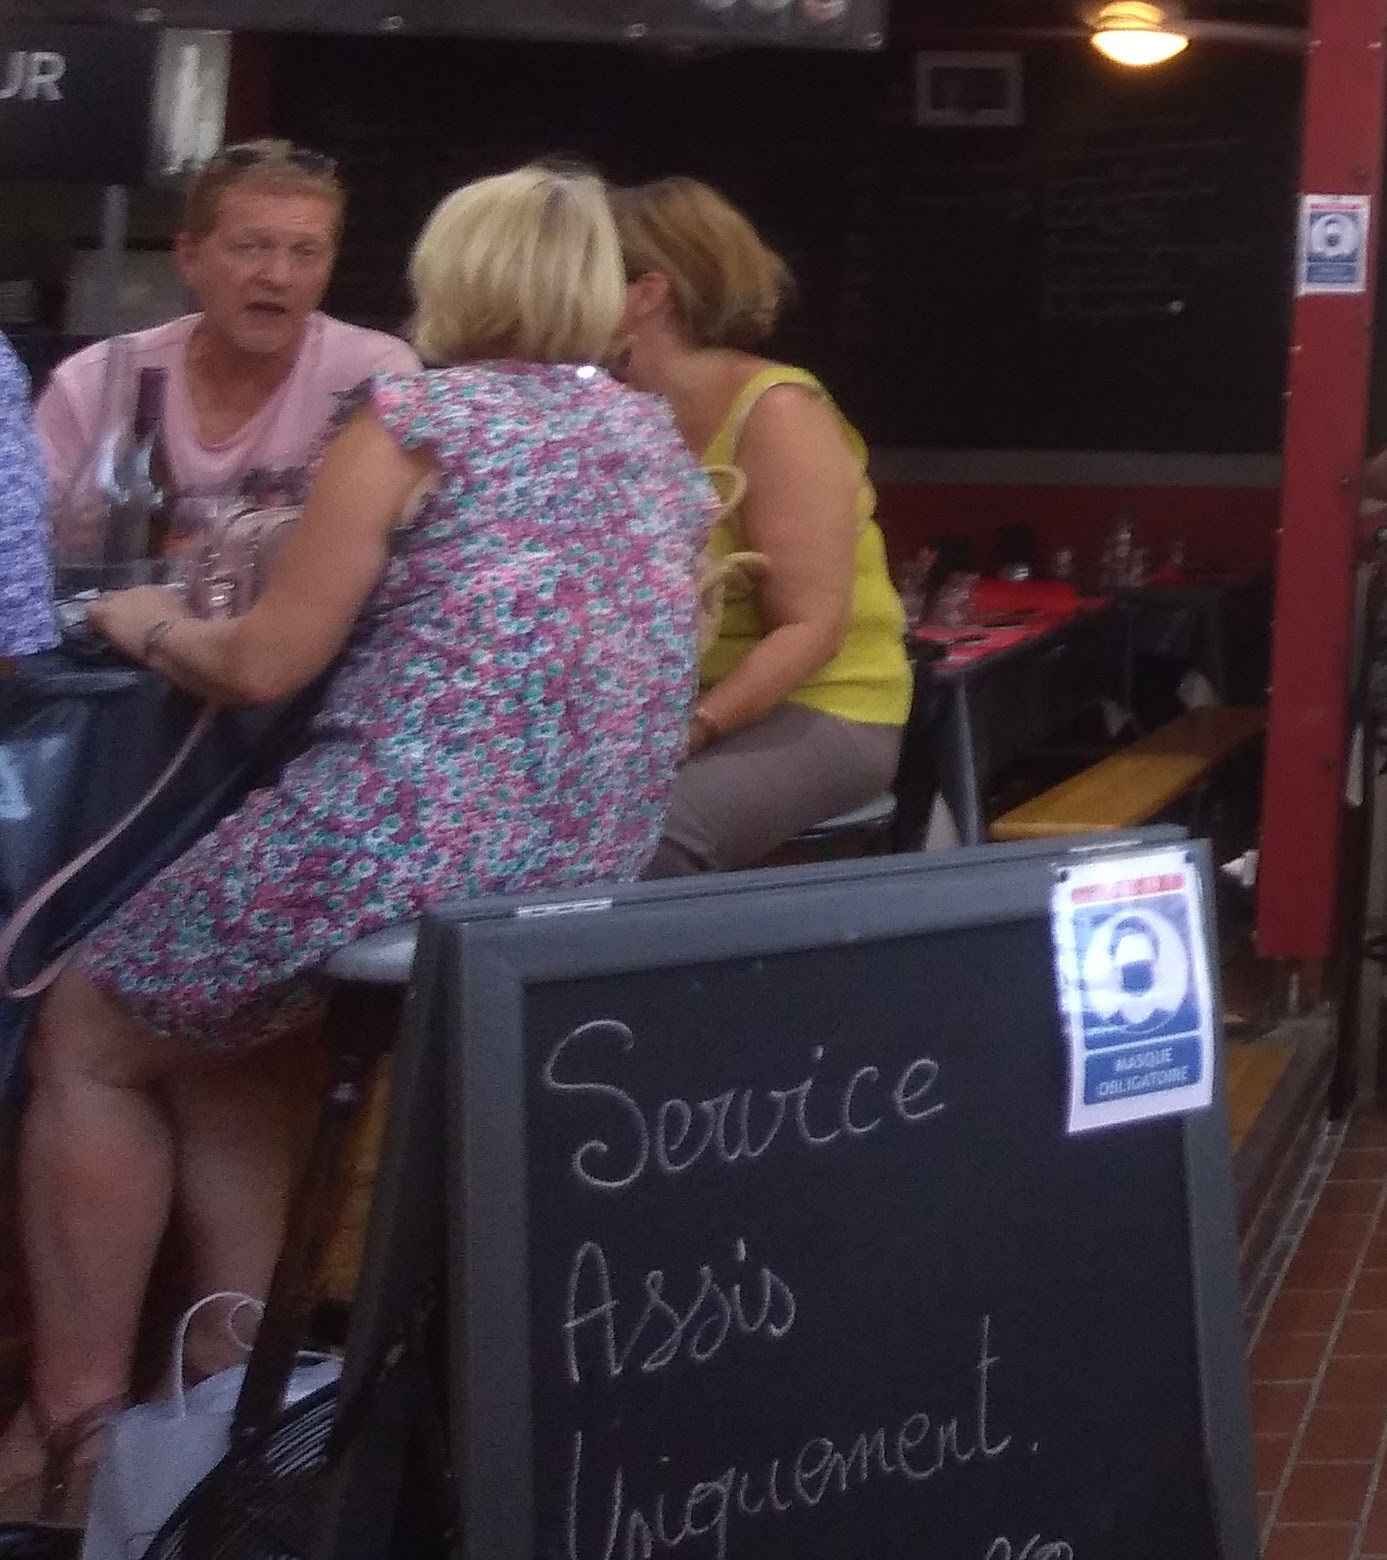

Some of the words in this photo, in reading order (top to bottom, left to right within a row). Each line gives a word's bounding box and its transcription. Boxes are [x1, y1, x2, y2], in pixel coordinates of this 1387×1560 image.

[542, 1018, 946, 1189] Service
[1097, 1065, 1189, 1097] OBLIGATOIRE
[1114, 1047, 1173, 1072] MASQUE
[563, 1238, 797, 1383] Assis
